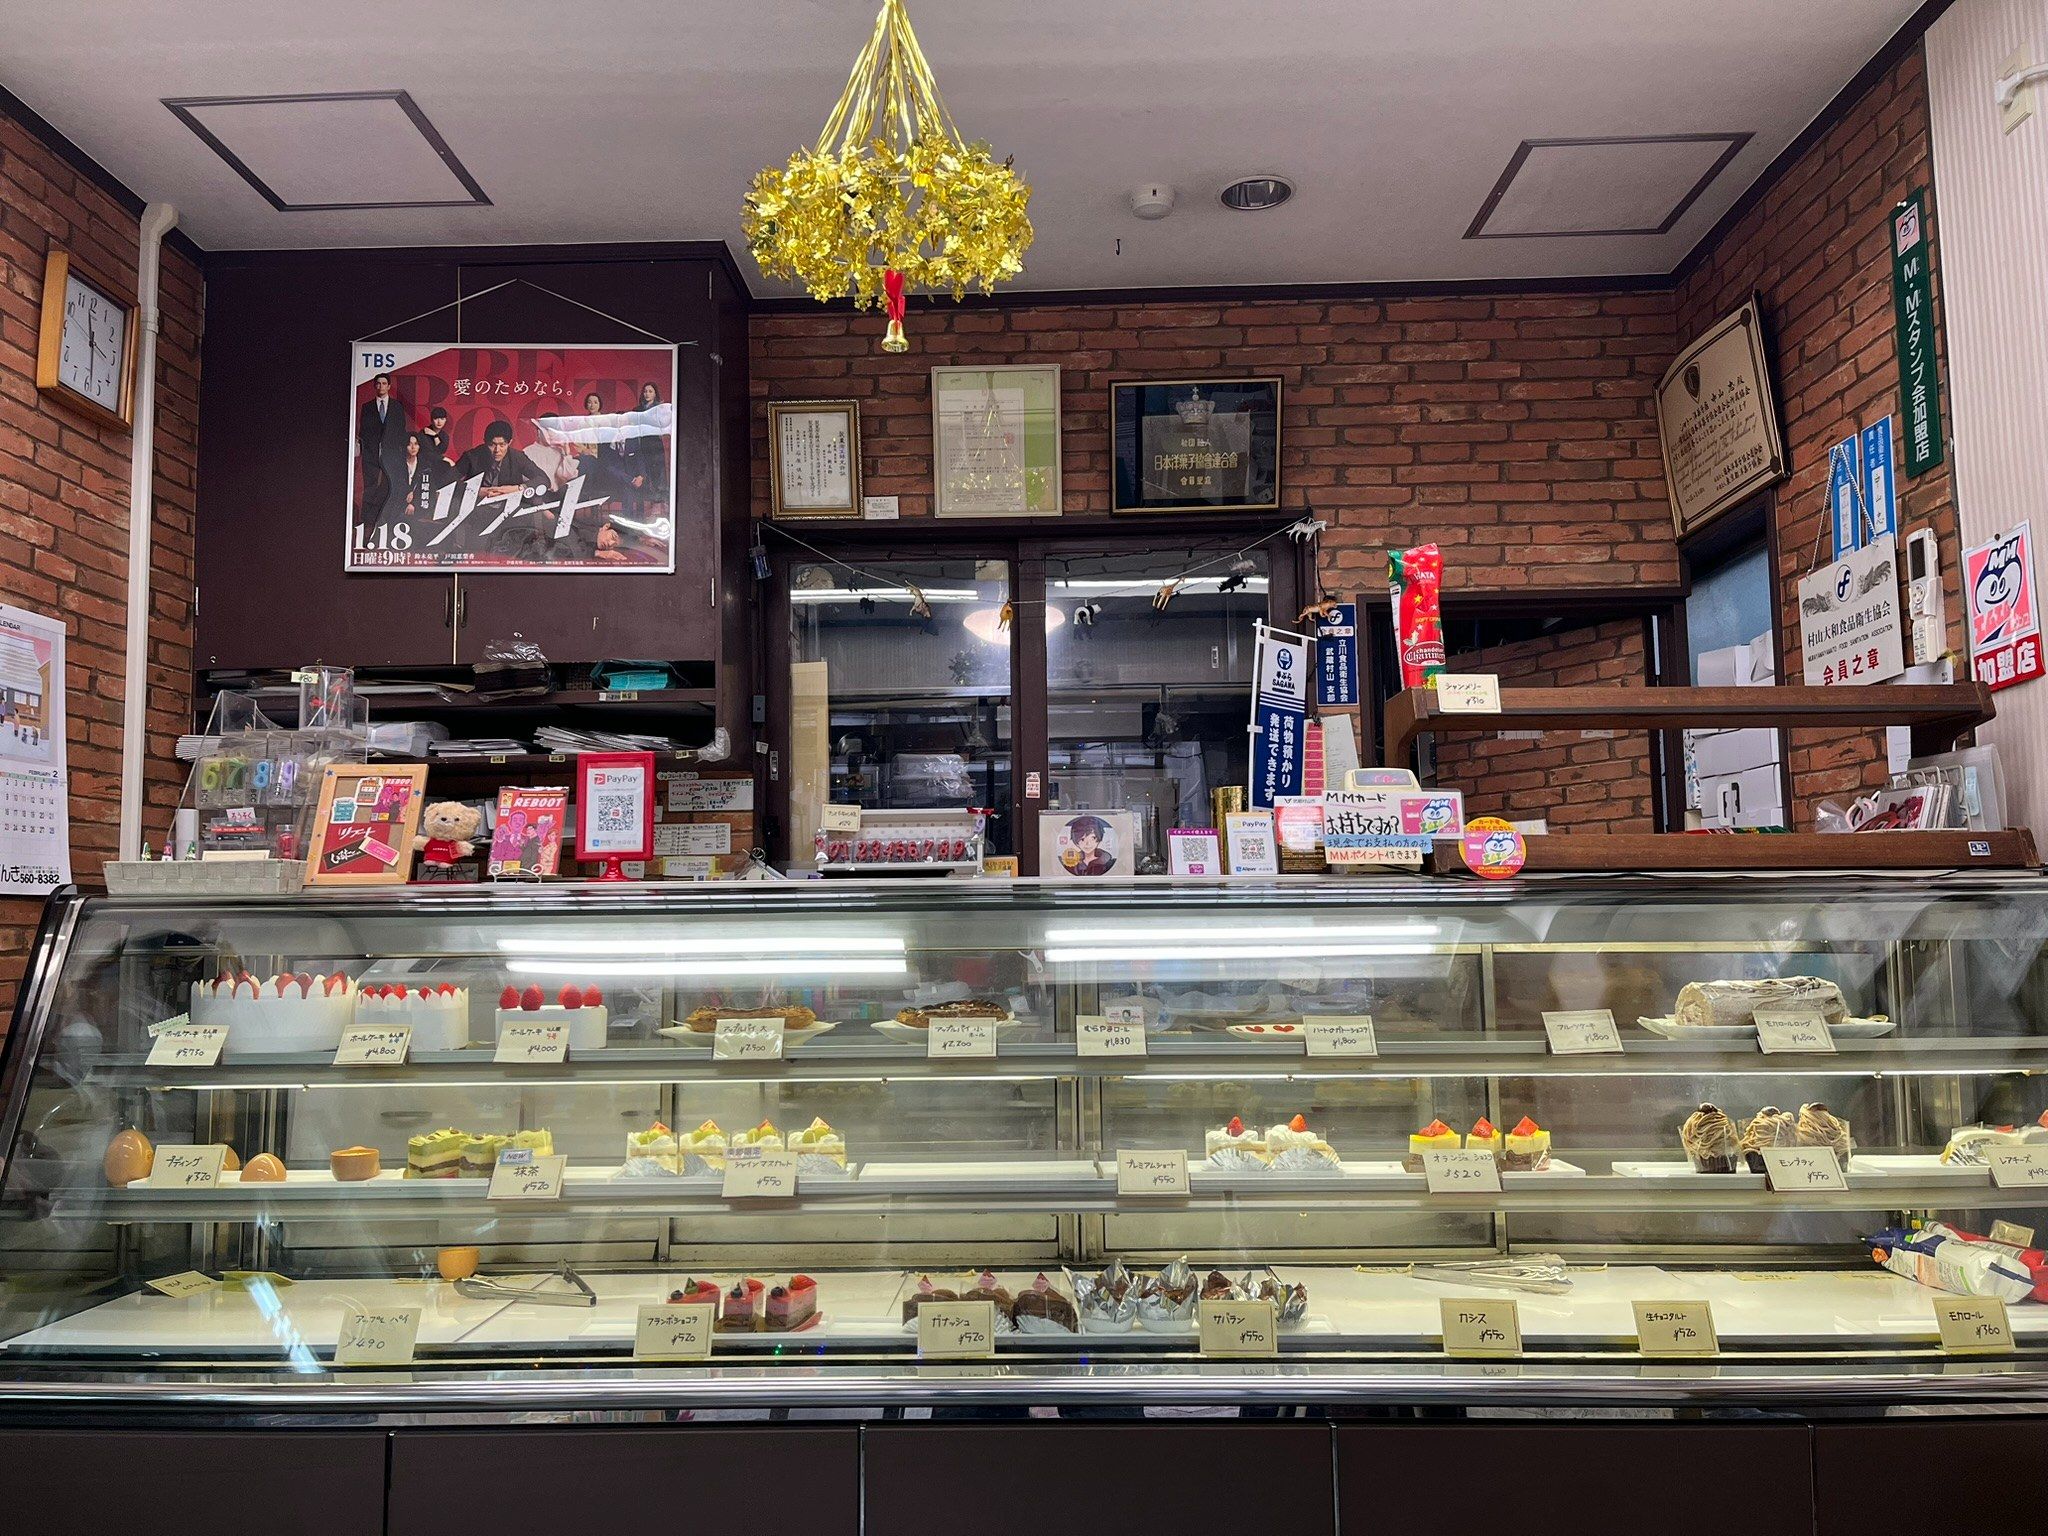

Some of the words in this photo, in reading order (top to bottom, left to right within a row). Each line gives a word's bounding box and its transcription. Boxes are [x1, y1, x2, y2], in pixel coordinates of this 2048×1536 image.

[362, 353, 395, 368] TBS
[453, 378, 574, 397] 愛のためなら。
[426, 472, 611, 547] リブート
[353, 522, 413, 551] 1.18
[1988, 539, 2019, 572] MM
[1808, 599, 1891, 648] 村山大和食品衛生協会
[1325, 647, 1335, 681] 武蔵村山
[1823, 648, 1880, 687] 会員之章
[1977, 641, 2038, 686] 加盟店
[1271, 679, 1296, 690] SAGAWA
[1445, 682, 1482, 691] シャンメリー
[1326, 685, 1336, 703] 支部
[1264, 713, 1280, 802] 発送できます
[1281, 715, 1295, 788] 荷物預かり
[52, 770, 58, 778] 2
[606, 775, 638, 784] PayPay
[513, 797, 564, 808] REBOOT
[1325, 792, 1387, 804] MMカード
[1430, 797, 1451, 807] MM
[1242, 820, 1268, 828] PayPay
[1326, 810, 1400, 836] お持ちですか?
[1491, 832, 1513, 840] MM
[1327, 838, 1429, 848] 現金でお支払の方のみ
[1329, 849, 1418, 861] MMポイント付きます
[0, 863, 21, 883] んき
[20, 873, 60, 885] 560-8382
[509, 1028, 543, 1036] ホールケーキ
[723, 1022, 757, 1032] アップルパイ
[935, 1025, 970, 1033] アップルパイ
[1556, 1022, 1596, 1031] フルーツケーキ
[165, 1030, 199, 1038] ホールケーキ
[349, 1034, 385, 1042] ホールケーキ
[941, 1040, 972, 1050] ¥2,200
[1104, 1036, 1131, 1048] ¥1,830
[1332, 1037, 1357, 1050] ¥1,800
[364, 1046, 396, 1059] ¥4,800
[527, 1044, 558, 1055] ¥4,000
[166, 1155, 202, 1168] プディング
[505, 1152, 527, 1161] NEW
[1779, 1156, 1815, 1167] モンブラン
[1998, 1153, 2033, 1165] レアチーズ
[734, 1160, 793, 1169] シャインマスカット
[1126, 1158, 1176, 1169] プレミアムショート
[513, 1165, 540, 1178] 抹茶
[1806, 1171, 1830, 1184] ¥550
[185, 1171, 212, 1185] ¥320
[756, 1175, 782, 1188] ¥550
[1152, 1175, 1176, 1186] ¥550
[522, 1181, 550, 1194] ¥520
[647, 1314, 699, 1327] フランボショコラ
[931, 1316, 970, 1328] ガナッシュ
[1212, 1313, 1246, 1325] サバラン
[1458, 1312, 1488, 1325] カシス
[1645, 1312, 1688, 1322] 生チョコタルト
[1948, 1310, 1985, 1322] モカロール
[1239, 1330, 1265, 1344] ¥550
[1478, 1330, 1505, 1343] ¥550
[1673, 1327, 1697, 1341] ¥520
[1975, 1324, 2001, 1339] ¥360
[671, 1332, 696, 1346] ¥520
[957, 1331, 985, 1346] ¥520
